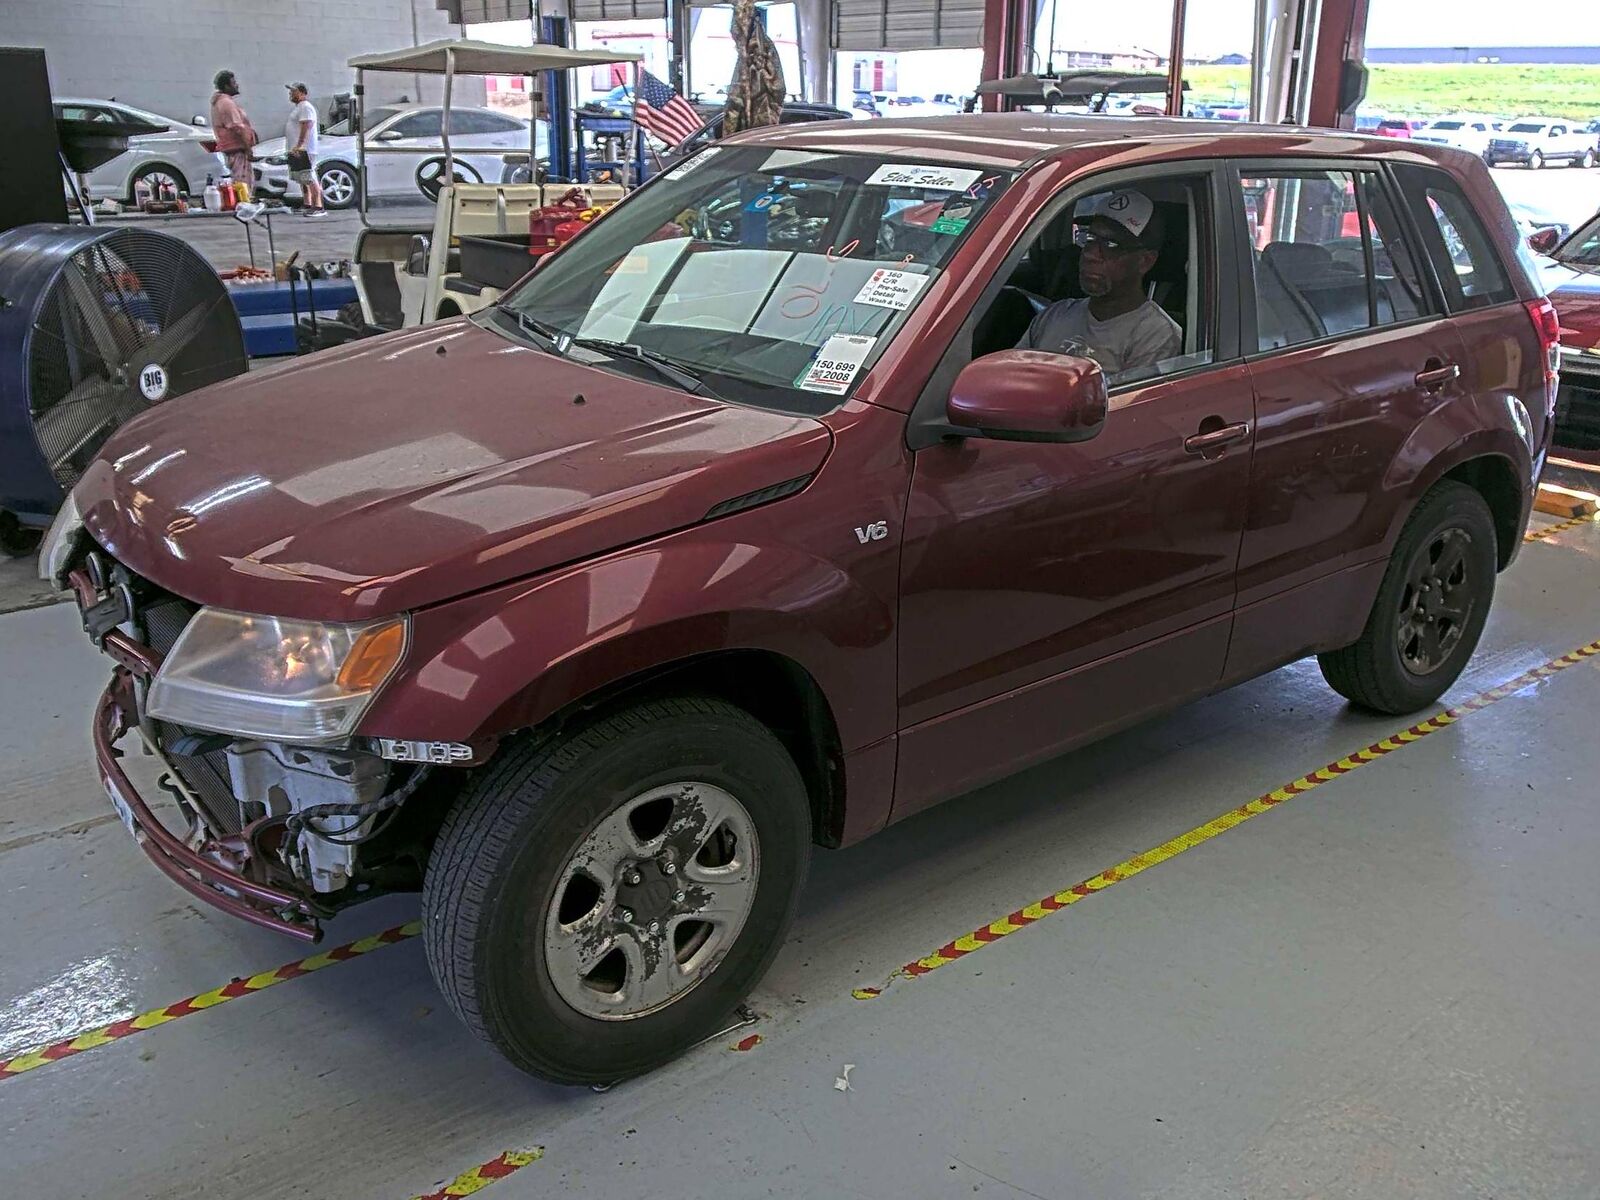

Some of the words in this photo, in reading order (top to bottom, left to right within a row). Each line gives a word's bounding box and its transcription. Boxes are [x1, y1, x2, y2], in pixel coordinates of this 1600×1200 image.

[881, 172, 913, 183] Elite
[914, 175, 954, 186] Seller
[887, 271, 903, 279] 360
[882, 277, 898, 285] C/R
[877, 284, 909, 293] Pre-Sale
[872, 290, 896, 298] Detail
[815, 360, 856, 372] 150,699
[143, 370, 162, 388] BIG
[823, 371, 850, 381] 2008
[854, 520, 888, 544] V6
